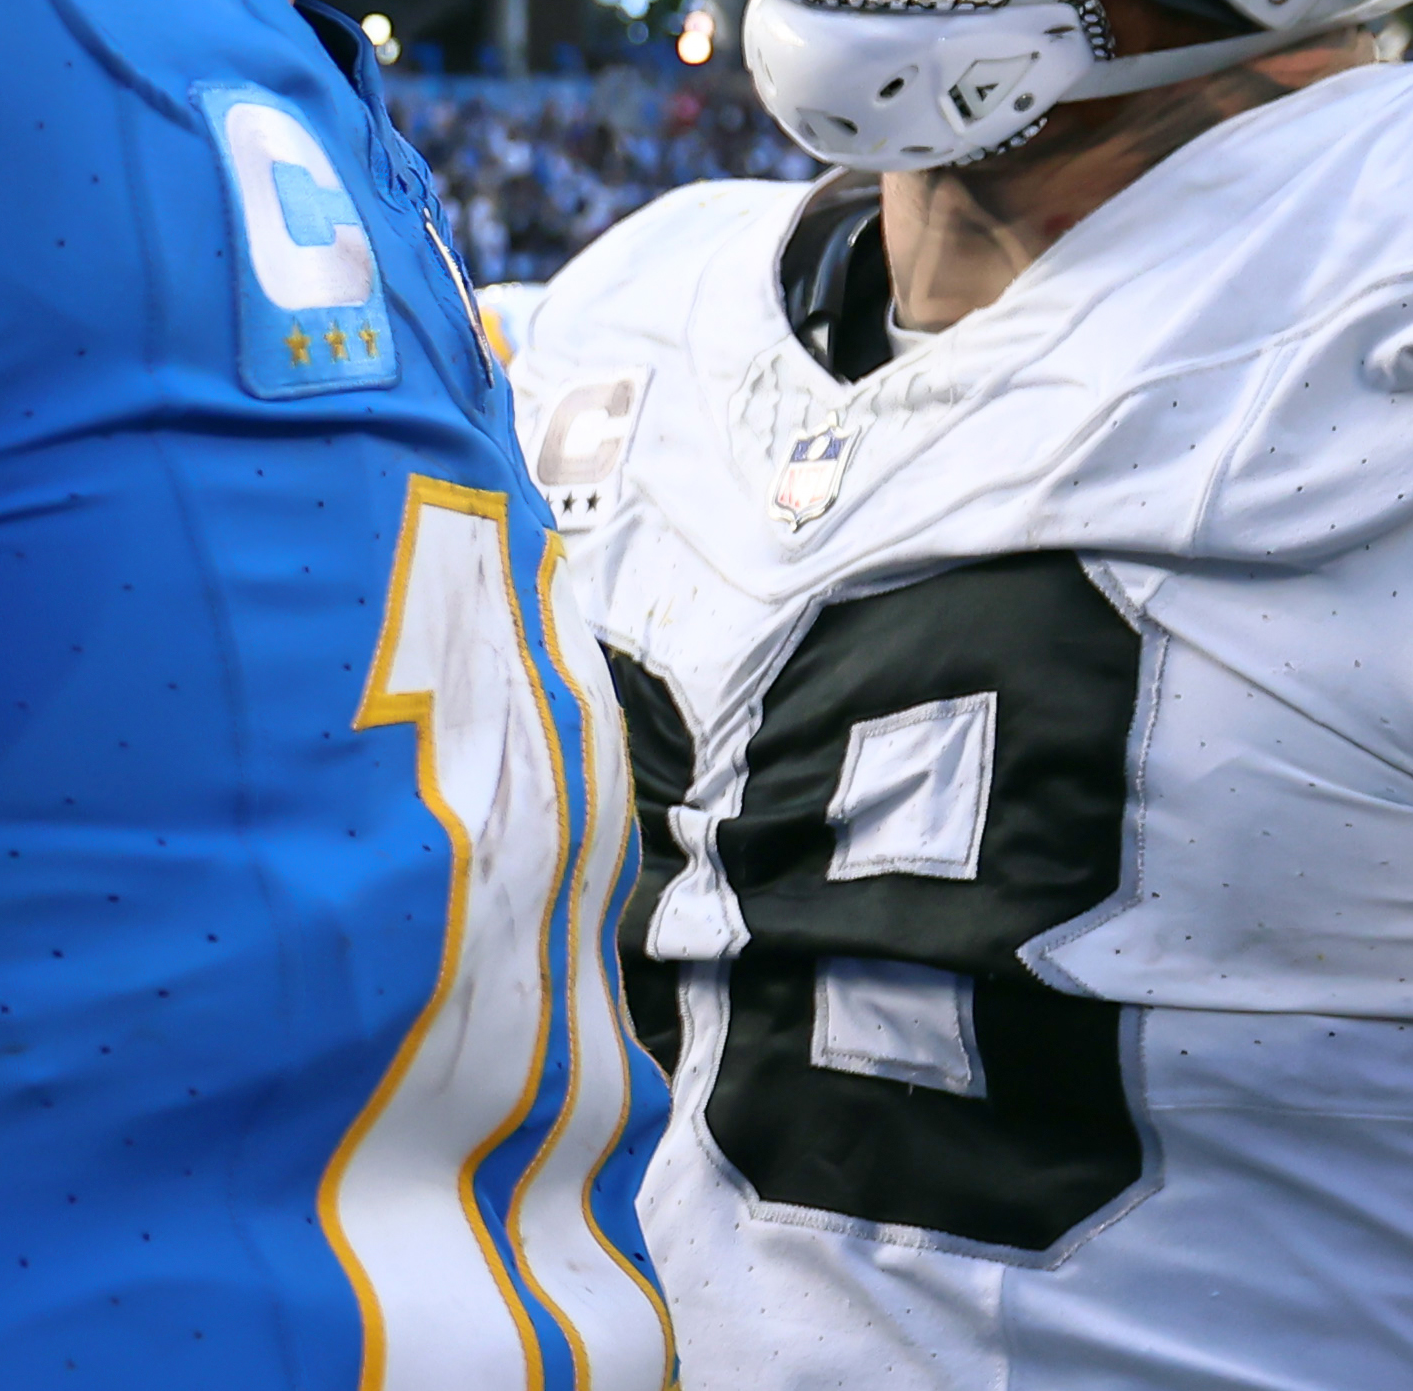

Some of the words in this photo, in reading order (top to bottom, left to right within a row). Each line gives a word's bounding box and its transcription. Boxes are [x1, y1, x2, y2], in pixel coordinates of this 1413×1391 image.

[225, 103, 378, 310] C
[537, 377, 637, 487] C
[596, 547, 1166, 1269] 8
